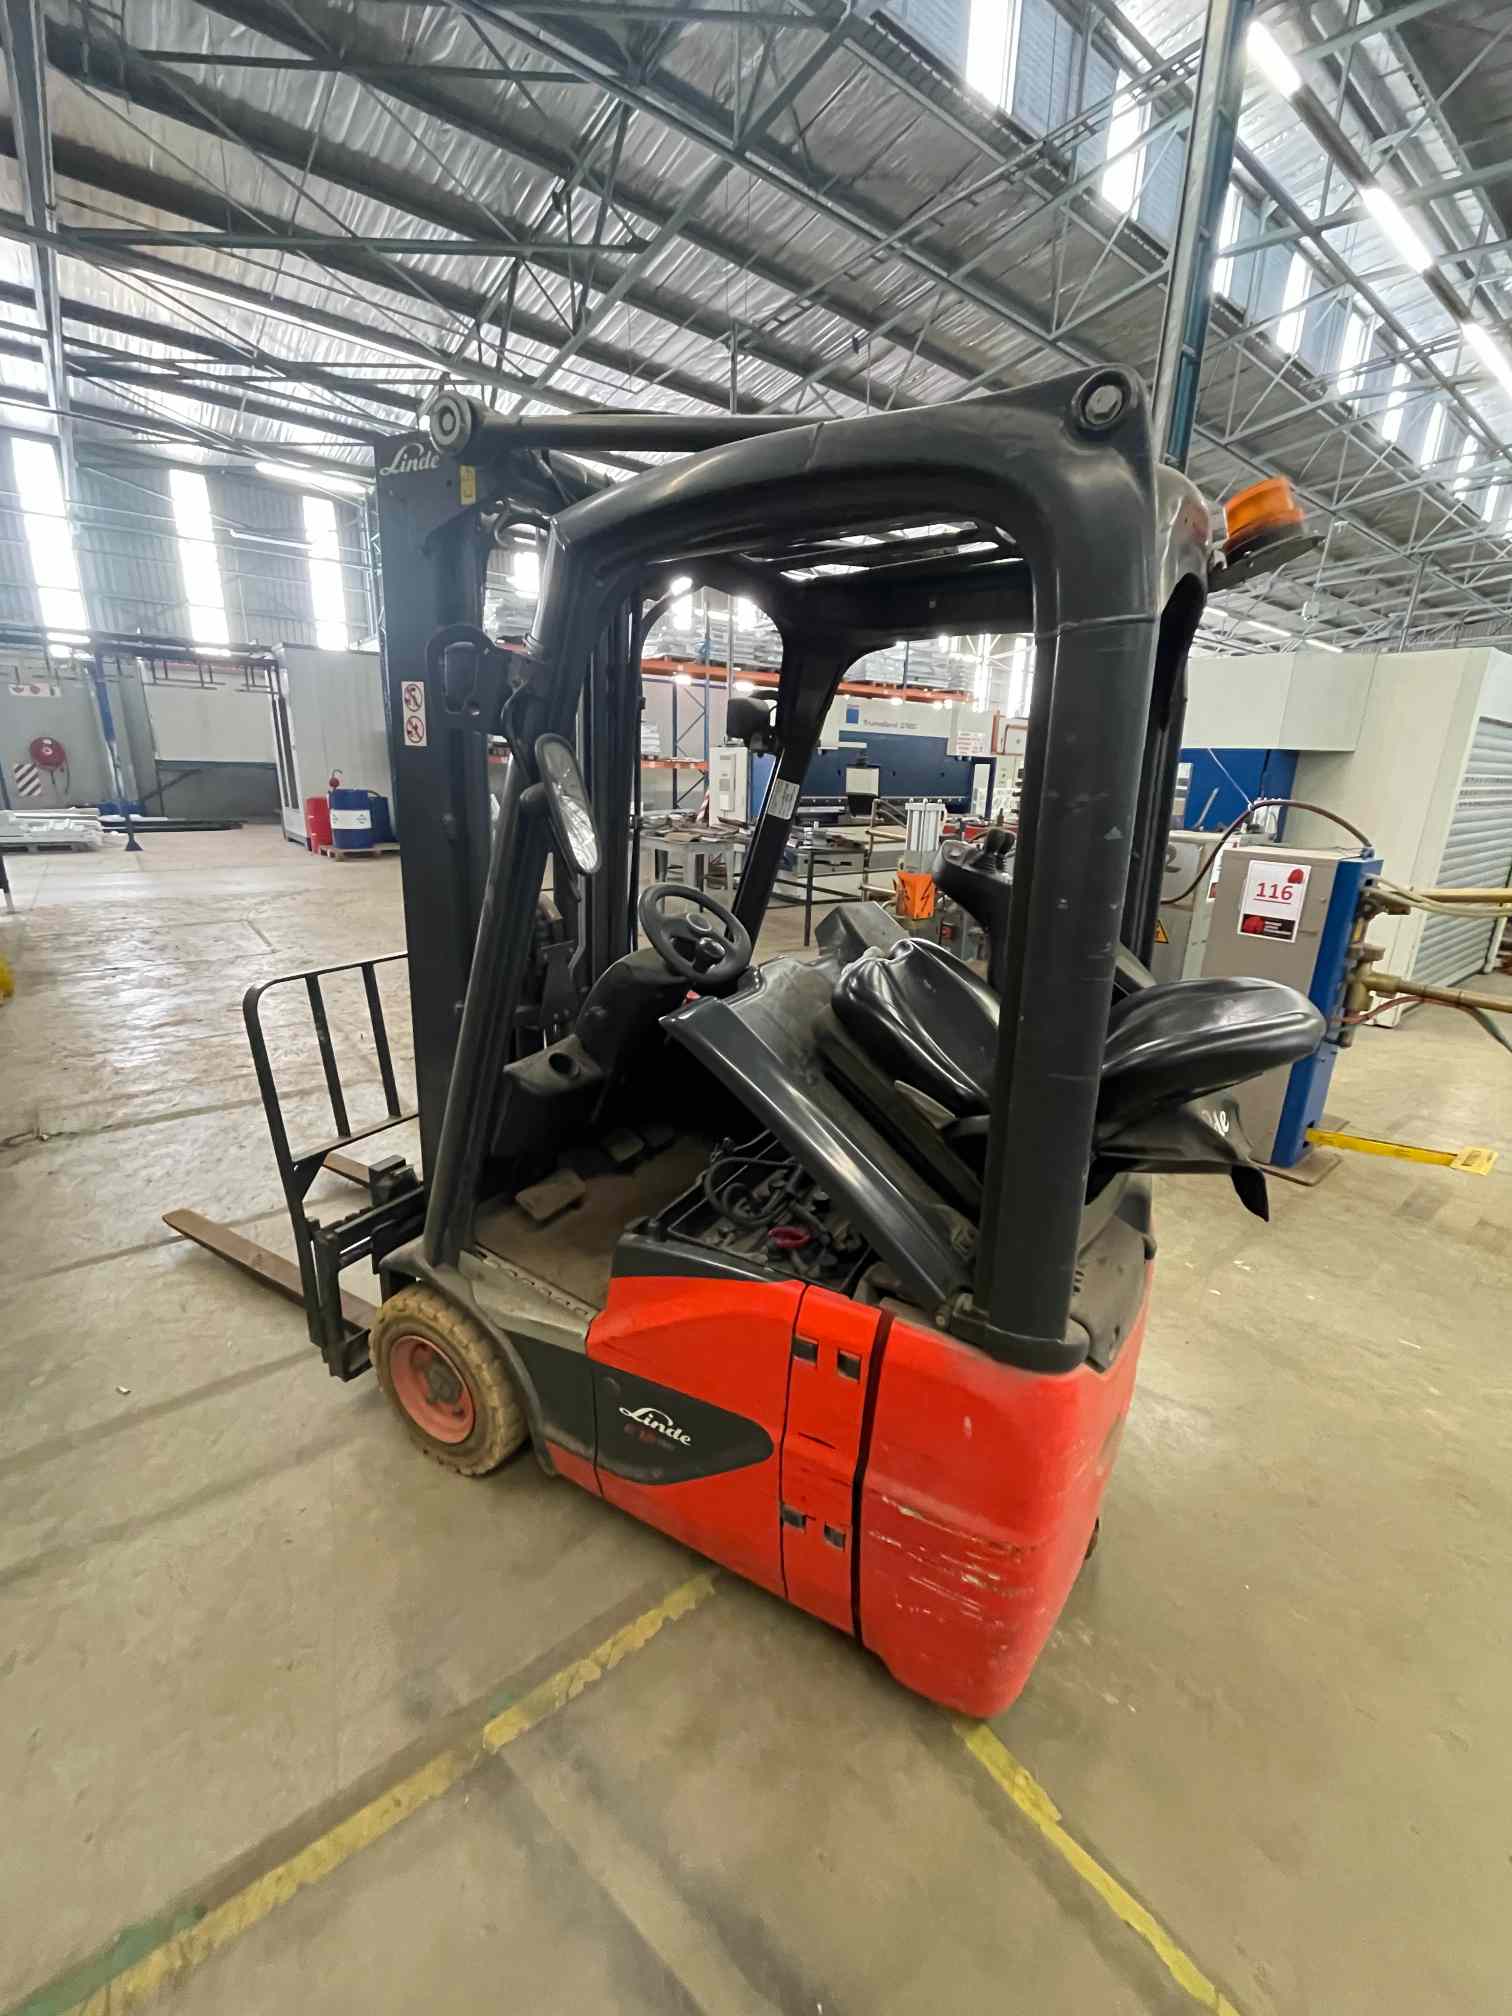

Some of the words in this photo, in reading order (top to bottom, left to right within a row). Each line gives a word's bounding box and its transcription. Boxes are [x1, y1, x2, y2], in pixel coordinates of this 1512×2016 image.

[379, 442, 441, 476] Linde
[1256, 882, 1294, 901] 116
[619, 1407, 691, 1446] Linde
